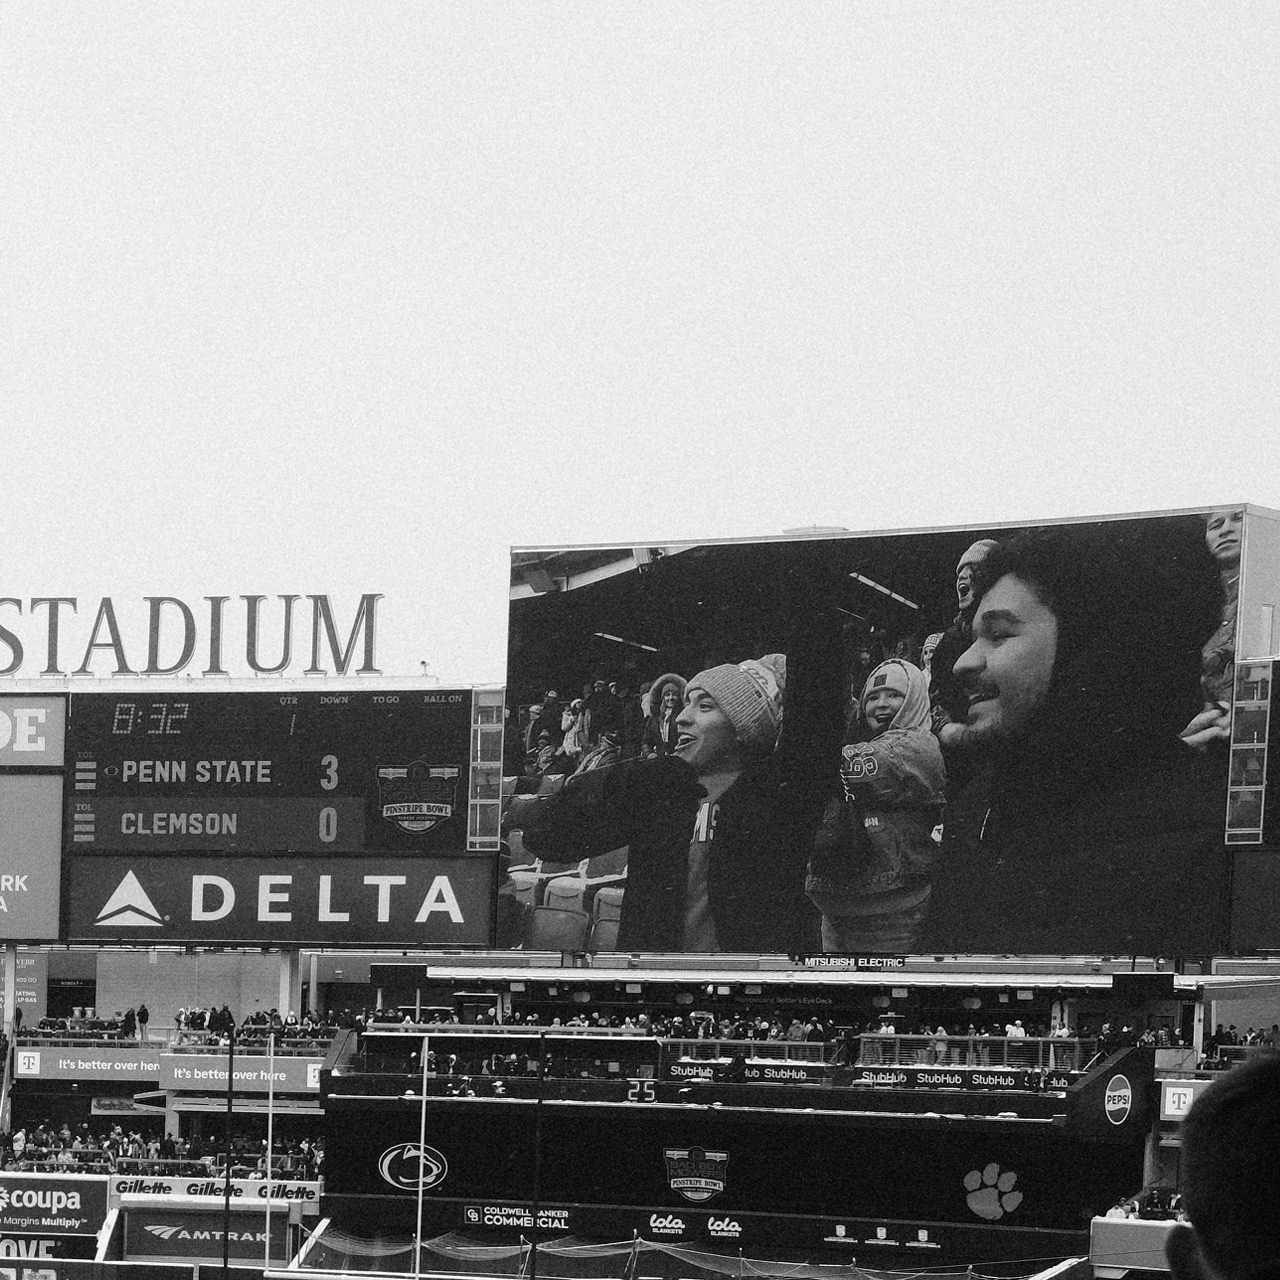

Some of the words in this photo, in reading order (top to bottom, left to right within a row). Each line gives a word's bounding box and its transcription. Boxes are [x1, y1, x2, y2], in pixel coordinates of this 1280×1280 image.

[320, 695, 349, 704] DOWN
[448, 694, 464, 703] ON
[111, 703, 190, 735] 8:32
[121, 760, 187, 784] PENN
[195, 760, 272, 784] STATE
[319, 754, 339, 791] 3
[426, 804, 451, 815] BOWL
[120, 811, 238, 836] CLEMSON
[318, 807, 338, 843] 0
[190, 873, 465, 924] DELTA
[804, 957, 855, 967] MITSUBISHI
[858, 958, 904, 968] ELECTRIC
[59, 1059, 74, 1070] It's
[77, 1059, 110, 1071] better
[114, 1061, 136, 1071] over
[174, 1068, 188, 1079] It's
[233, 1071, 257, 1080] over
[670, 1065, 713, 1078] StubHub
[764, 1068, 807, 1080] StubHub
[862, 1071, 907, 1083] StubHub
[916, 1073, 962, 1086] StubHub
[972, 1075, 1015, 1087] StubHub
[1106, 1094, 1131, 1106] PEPSI
[115, 1180, 172, 1196] Gillette
[9, 1187, 81, 1214] coupa
[484, 1206, 531, 1217] COLDWELL
[3, 1217, 40, 1228] Margins
[650, 1213, 686, 1229] lola
[708, 1216, 742, 1232] lola
[178, 1230, 269, 1242] AMTRAK
